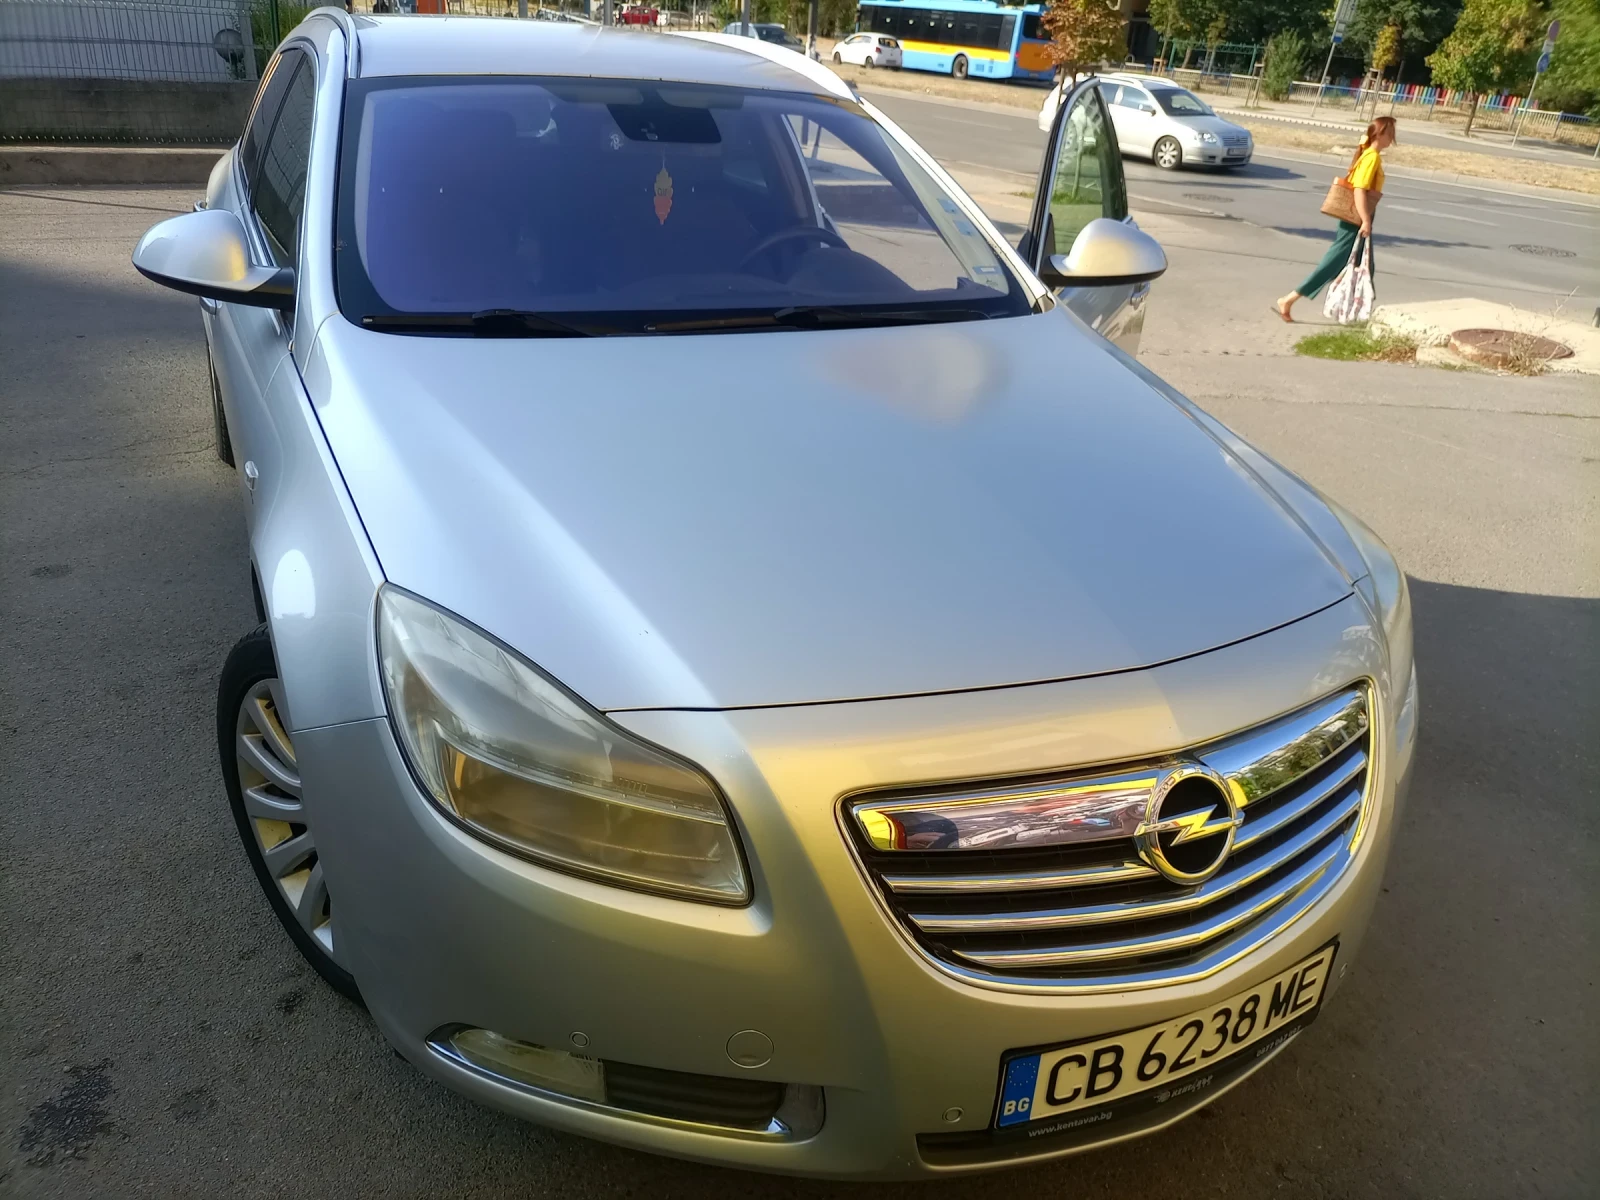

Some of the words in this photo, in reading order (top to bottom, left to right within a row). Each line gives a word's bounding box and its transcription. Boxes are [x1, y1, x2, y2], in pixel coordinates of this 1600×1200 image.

[1045, 1044, 1125, 1107] CB
[1136, 993, 1261, 1083] 6238
[1263, 956, 1325, 1030] ME
[1003, 1097, 1030, 1117] BG
[1028, 1110, 1113, 1138] www.kentavar.bg
